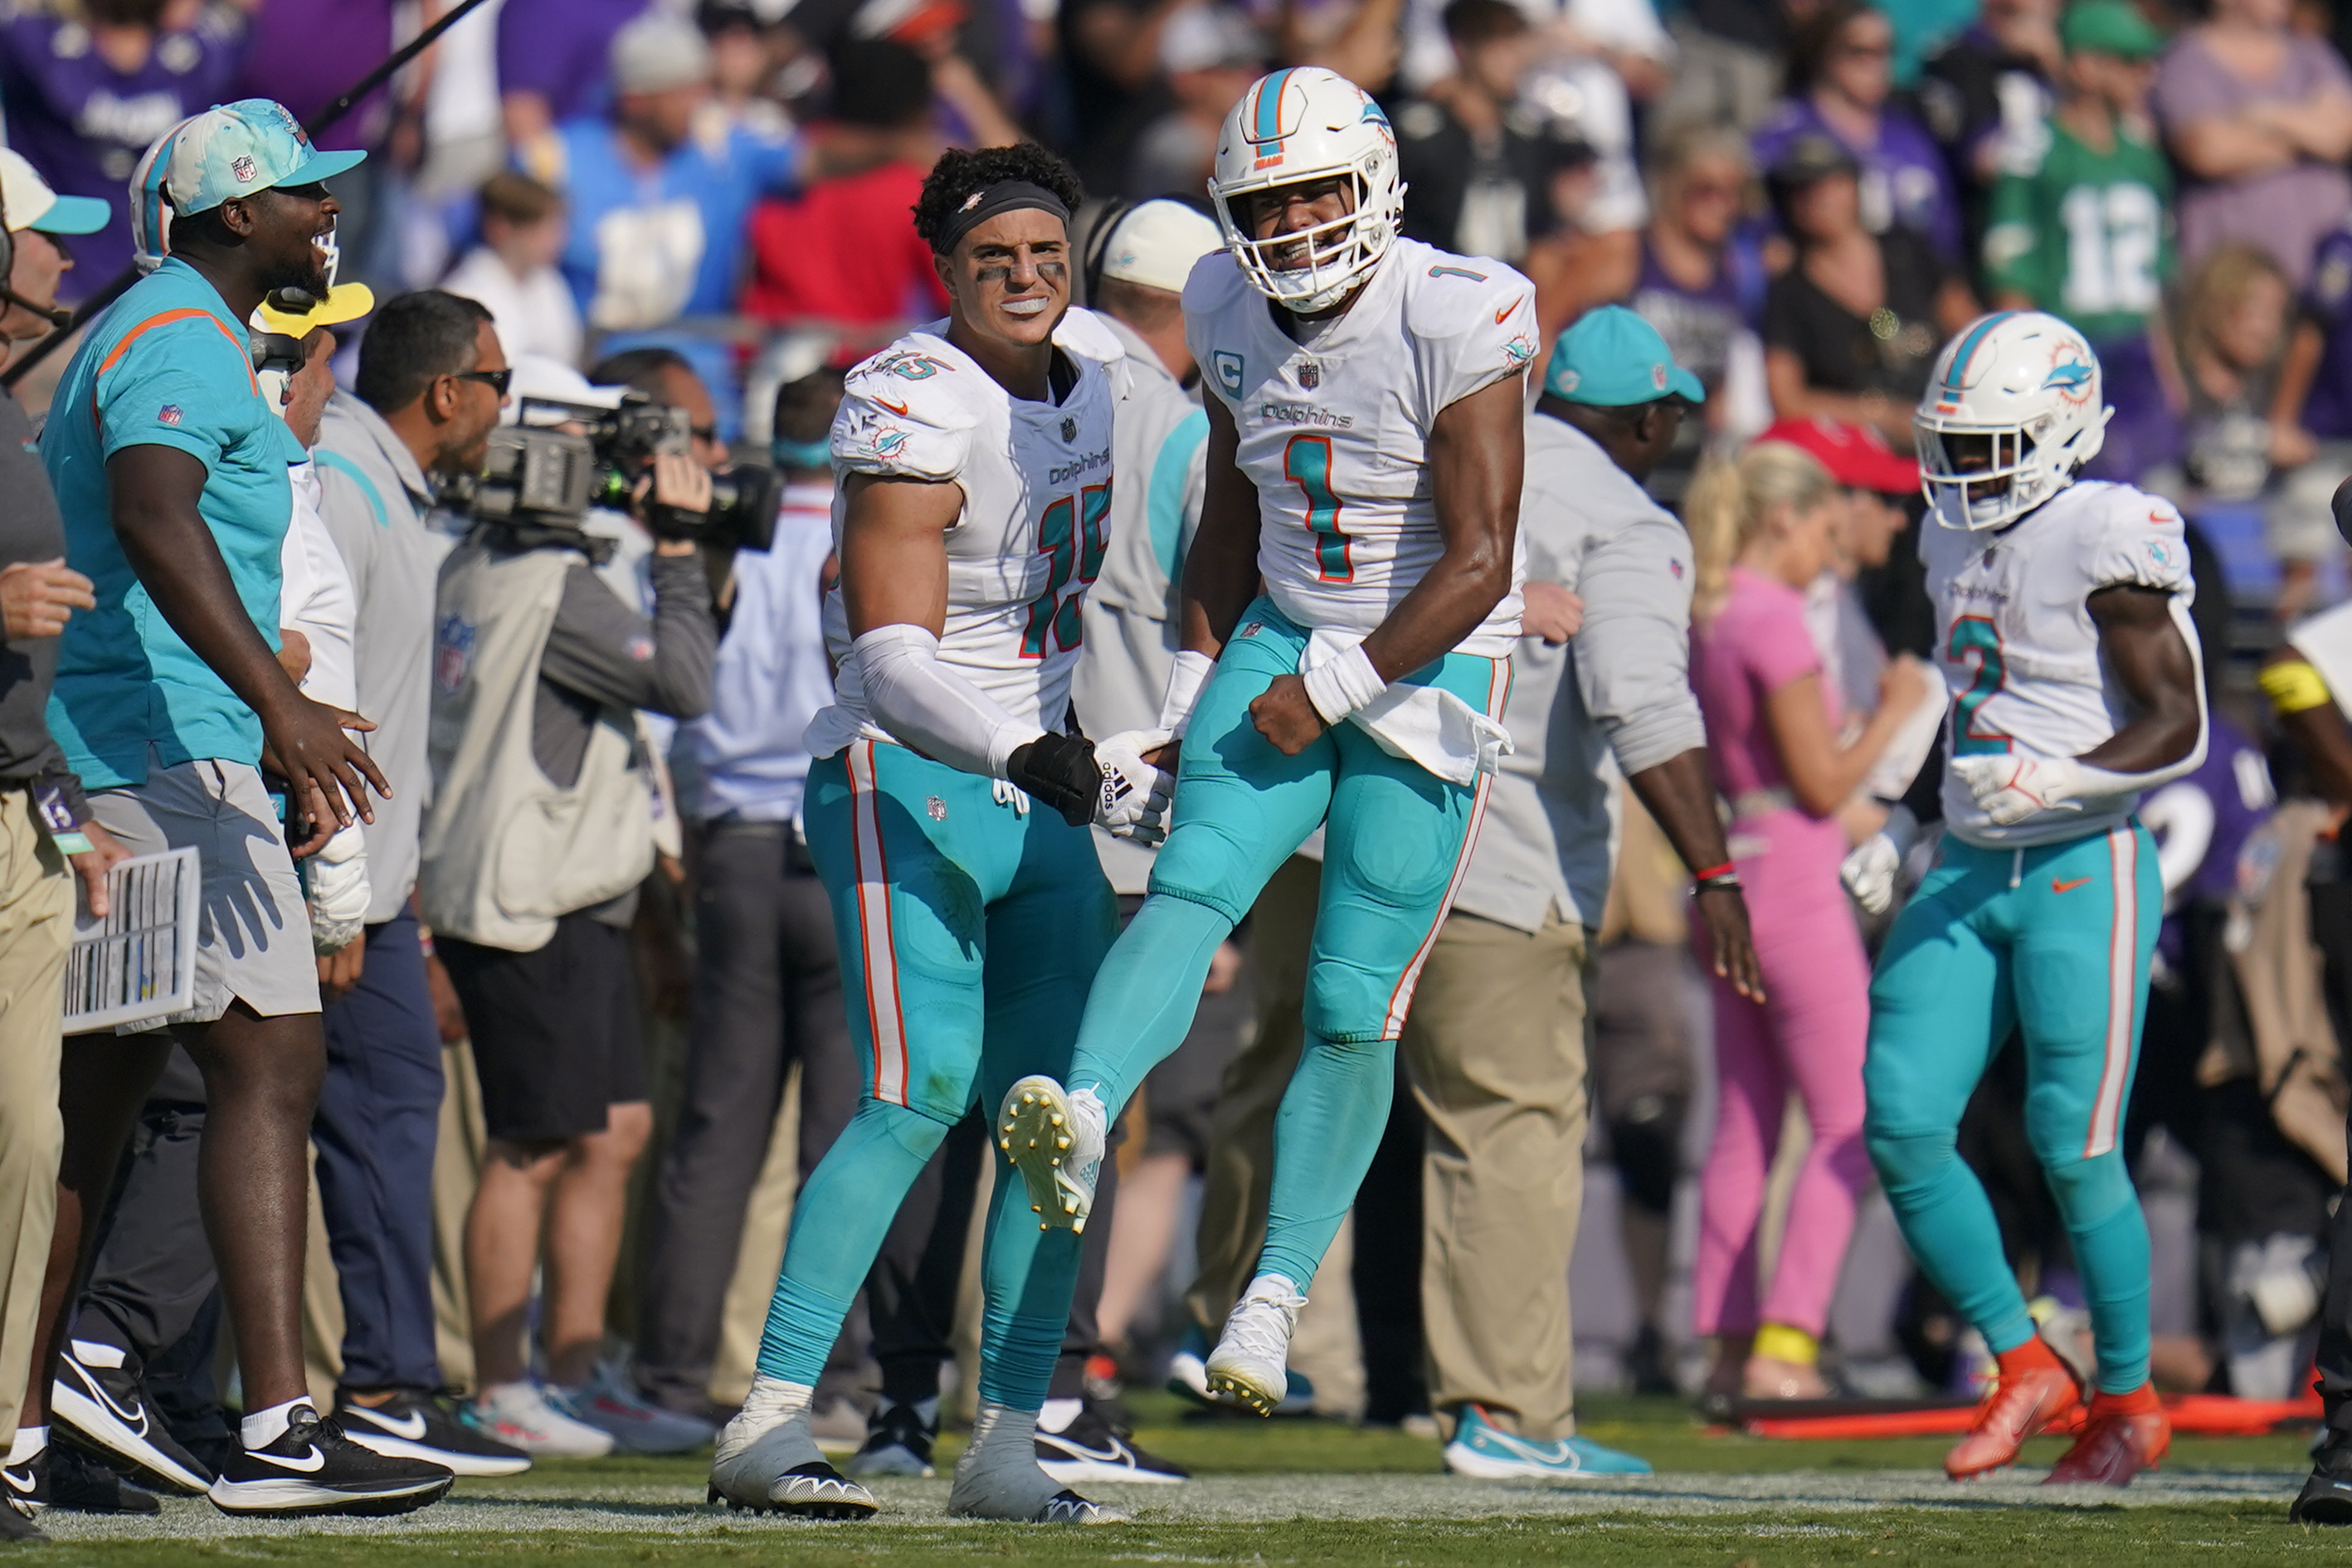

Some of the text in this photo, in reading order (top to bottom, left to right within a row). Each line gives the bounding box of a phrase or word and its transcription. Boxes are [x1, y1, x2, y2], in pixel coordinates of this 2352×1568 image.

[236, 164, 255, 179] NFL
[2059, 181, 2161, 312] 12
[1428, 265, 1488, 282] 1
[1216, 353, 1241, 388] C
[1301, 375, 1317, 386] NFL
[160, 411, 178, 423] NFL
[1262, 402, 1353, 429] Dolphins
[1049, 446, 1109, 485] Dolphins
[1283, 434, 1354, 582] 1
[1019, 477, 1113, 659] 15
[1946, 615, 2011, 757] 2
[1103, 762, 1114, 811] adidas
